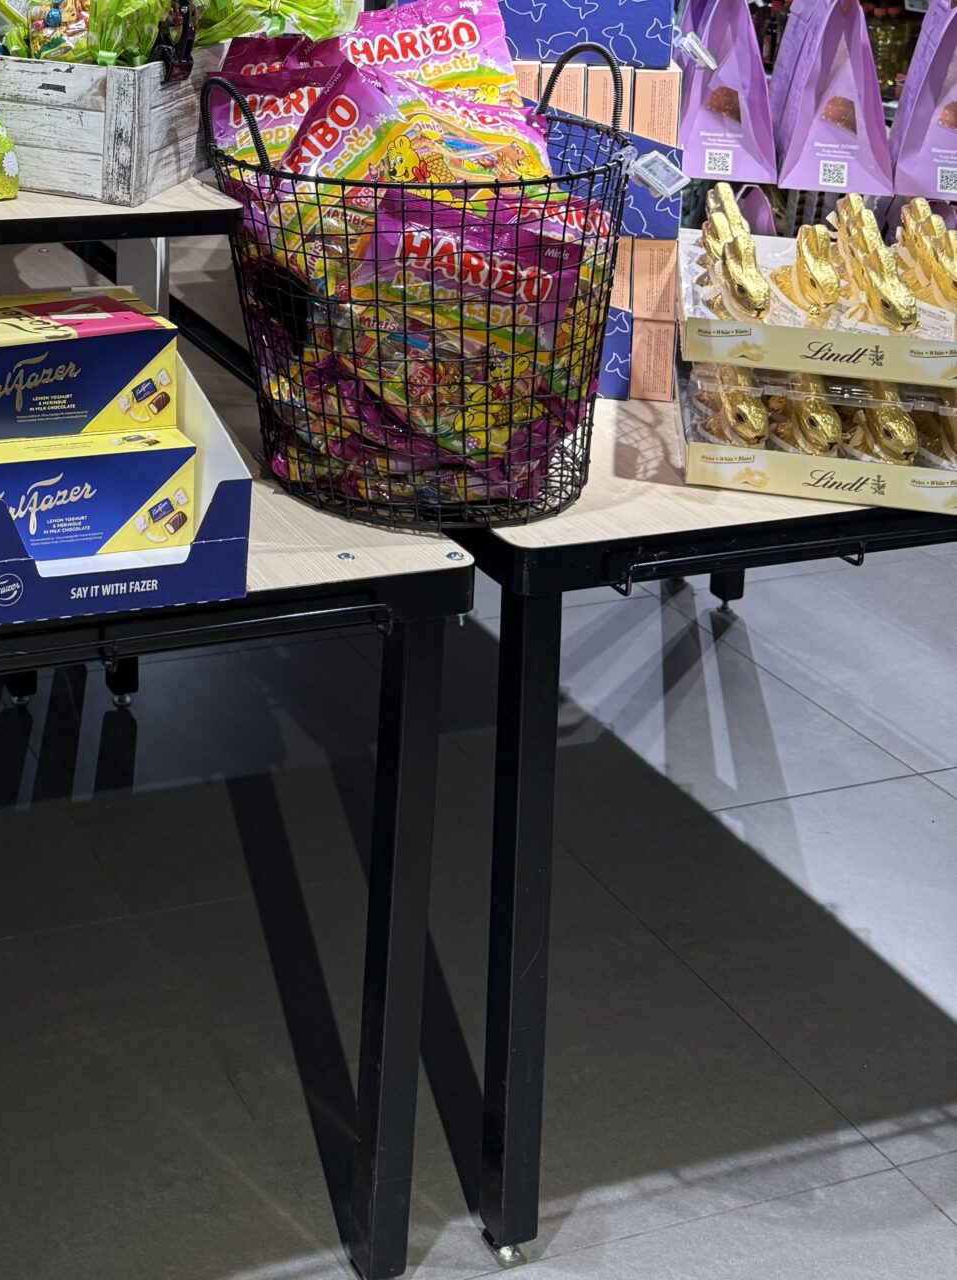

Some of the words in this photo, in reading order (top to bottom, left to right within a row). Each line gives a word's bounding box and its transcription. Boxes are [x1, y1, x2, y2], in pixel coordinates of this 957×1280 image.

[348, 20, 480, 66] HARIBO
[420, 52, 480, 79] Easter
[230, 86, 324, 128] HARI
[284, 94, 360, 175] RIBO
[394, 228, 553, 306] HARIBO
[544, 247, 570, 260] Minis
[800, 341, 869, 365] Lindt
[12, 351, 81, 412] Fazer
[802, 469, 871, 493] Lindt
[27, 472, 97, 535] Fazer
[62, 525, 91, 533] CHOCOLATE
[70, 587, 88, 599] SAY
[90, 586, 100, 597] IT
[101, 583, 127, 596] WITH
[129, 579, 158, 593] FAZER
